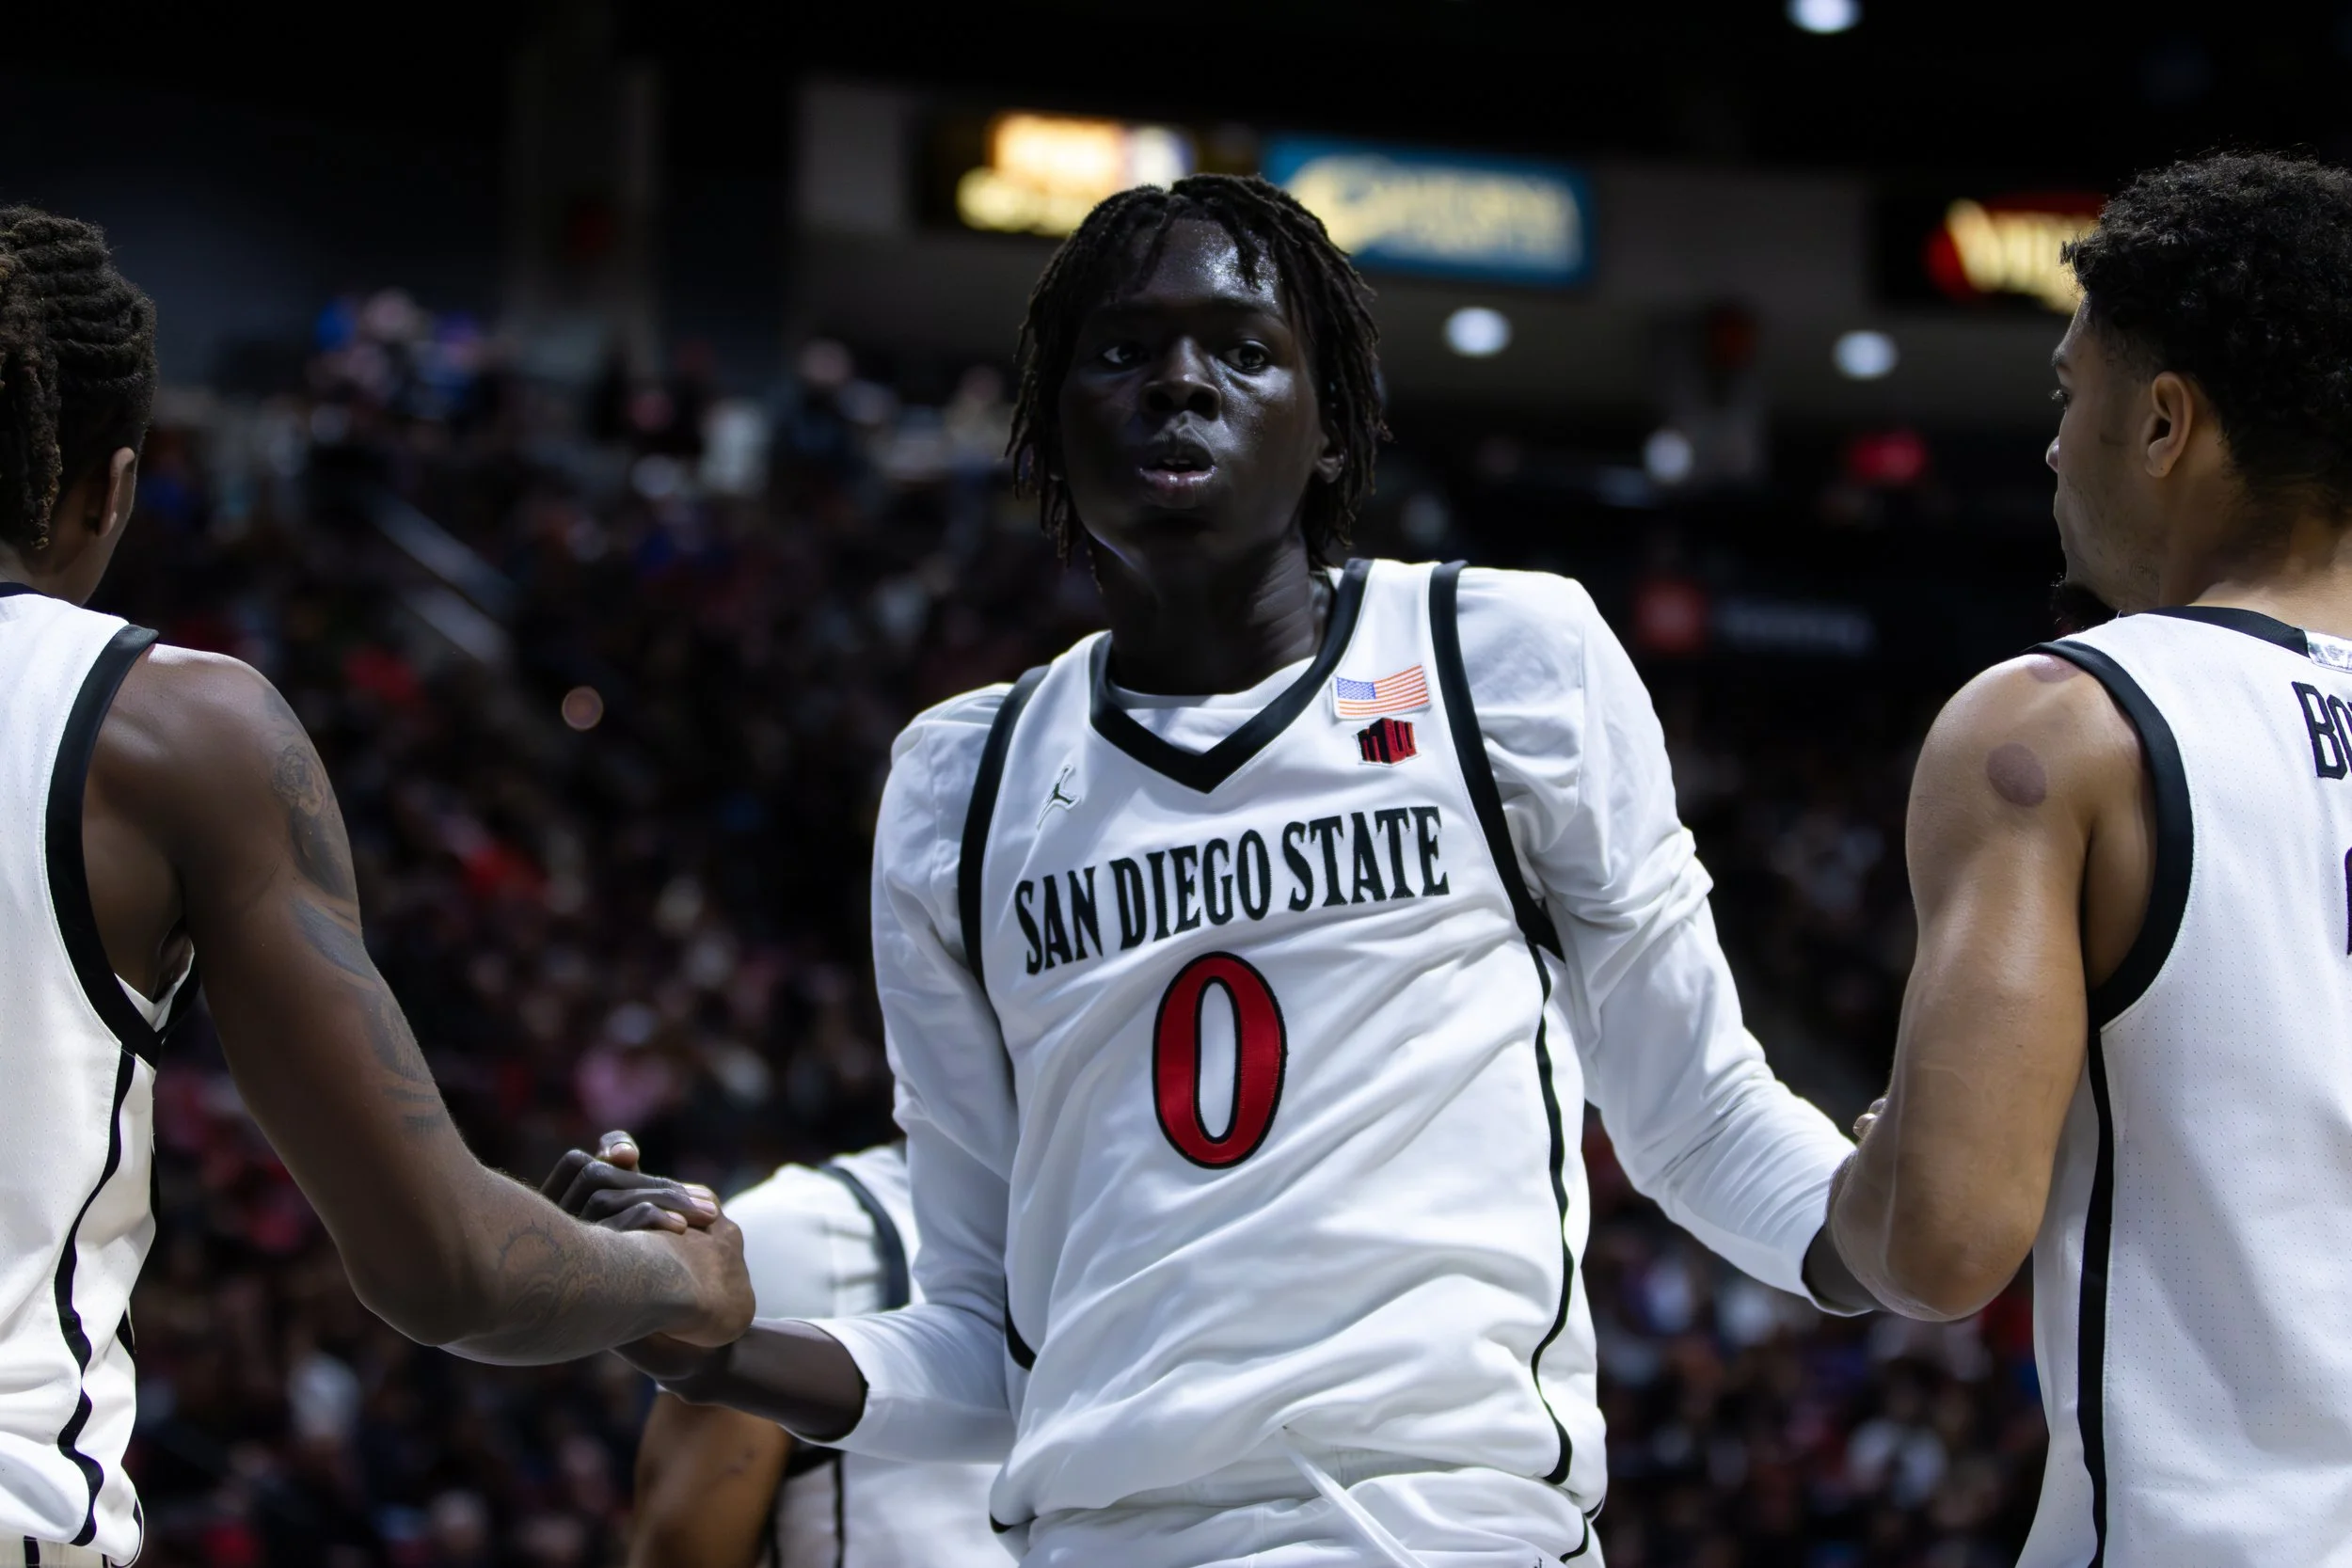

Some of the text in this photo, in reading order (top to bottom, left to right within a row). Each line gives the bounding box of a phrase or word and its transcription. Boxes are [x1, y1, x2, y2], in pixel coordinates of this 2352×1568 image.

[2292, 681, 2352, 780] BO
[1014, 806, 1450, 975] SAN DIEGO STATE
[1152, 951, 1288, 1169] 0
